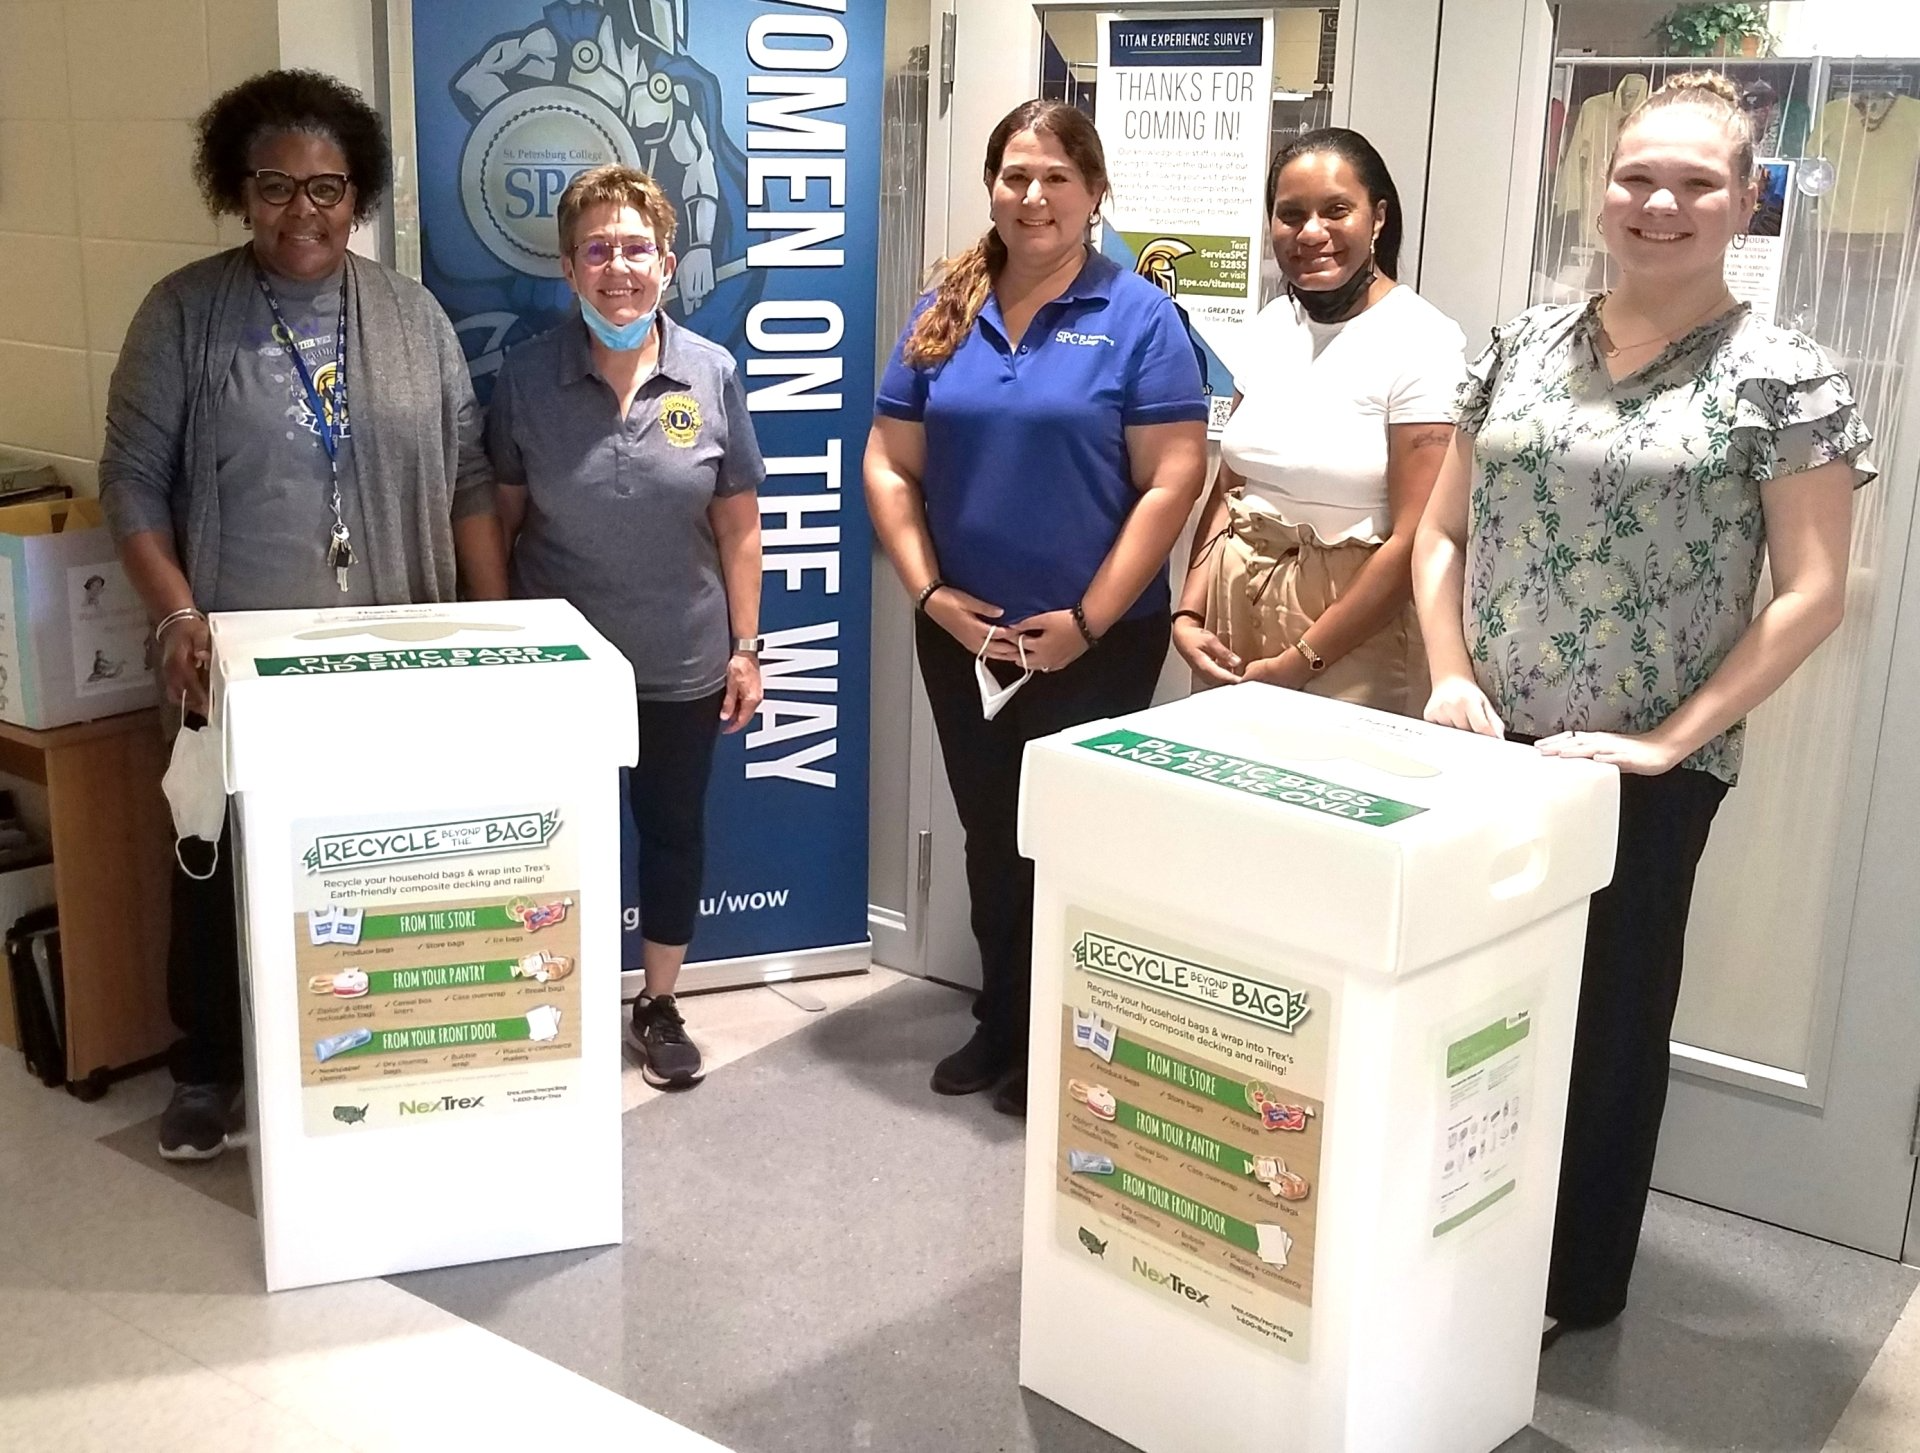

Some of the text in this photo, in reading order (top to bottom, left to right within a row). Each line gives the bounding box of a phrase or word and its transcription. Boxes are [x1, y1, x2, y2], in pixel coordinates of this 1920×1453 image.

[1119, 32, 1254, 47] TITAN EXPERIENCE SURVEY
[1115, 71, 1254, 102] THANKS FOR
[1125, 110, 1240, 141] COMING IN!
[503, 149, 602, 161] St. Petersburg College
[504, 167, 593, 219] SP
[1201, 249, 1248, 260] ServiceSPC
[1230, 240, 1248, 250] Text
[1210, 260, 1247, 270] to 52855
[1219, 271, 1247, 280] or visit
[1208, 306, 1229, 315] GREAT
[1231, 307, 1245, 315] DAY
[1055, 331, 1079, 345] SPC
[745, 300, 845, 412] ON
[755, 439, 842, 594] THE
[280, 651, 569, 675] AND FILMS ONLY
[298, 646, 544, 667] PLASTIC BAGS
[745, 621, 840, 789] WAY
[1093, 742, 1384, 820] AND FILMS ONLY
[1135, 738, 1379, 808] PLASTIC BAGS
[324, 820, 538, 862] RECYCLE BEYOND BAG
[451, 837, 473, 847] THE
[323, 862, 551, 889] Recycle your household bags & wrap into Trex's
[330, 874, 546, 899] Earth-friendly composite decking and railing!
[400, 910, 477, 933] FROM THE STORE
[393, 965, 486, 989] FROM YOUR PANTRY
[1089, 941, 1285, 1018] RECYCLE BEYOND BAG
[1199, 984, 1219, 1000] THE
[383, 1022, 497, 1049] FROM YOUR FRONT DOOR
[1086, 980, 1295, 1065] Recycle your household bags & wrap into Trex's
[1090, 995, 1287, 1076] Earth-friendly composite decking and railing!
[1146, 1051, 1216, 1096] FROM THE STORE
[399, 1095, 485, 1116] NexTrex
[1136, 1111, 1220, 1163] FROM YOUR PANTRY
[1122, 1173, 1227, 1236] FROM YOUR FRONT DOOR
[1132, 1255, 1210, 1309] NexTrex
